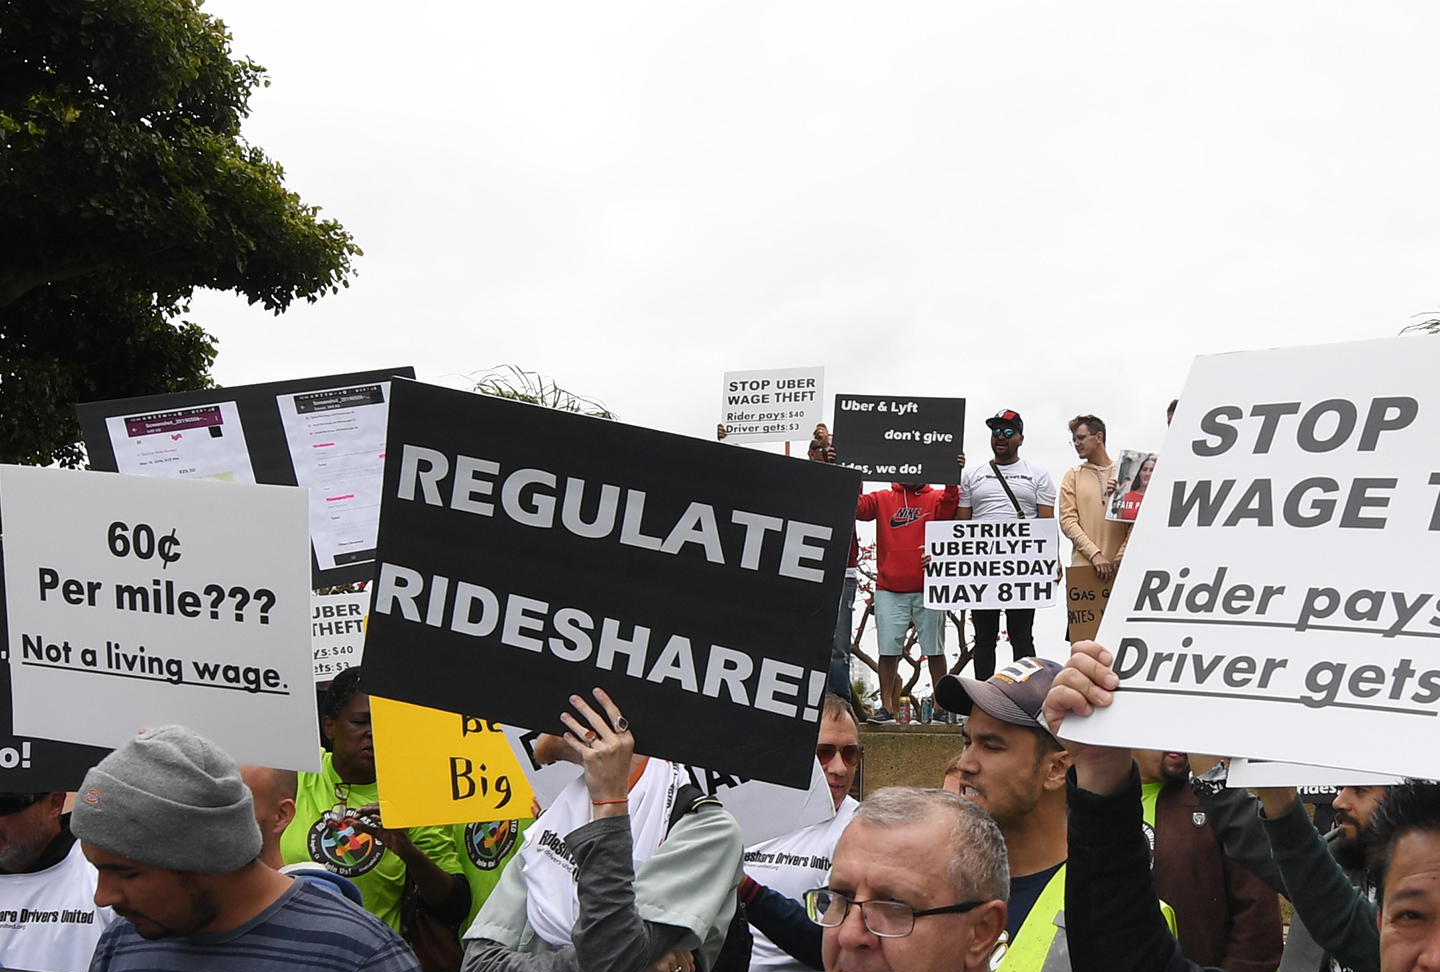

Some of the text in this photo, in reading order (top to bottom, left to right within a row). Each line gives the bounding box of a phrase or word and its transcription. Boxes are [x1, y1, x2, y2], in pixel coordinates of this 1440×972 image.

[729, 378, 816, 392] STOP UBER
[727, 391, 816, 405] WAGE THEFT
[727, 411, 756, 421] Rider
[841, 400, 919, 415] Uber & Lyft
[726, 424, 760, 434] Driver
[1191, 396, 1418, 456] STOP
[884, 429, 953, 445] don't give
[875, 464, 897, 475] we
[899, 463, 923, 475] do!
[1116, 500, 1134, 510] FAIR
[1167, 477, 1398, 529] WAGE
[396, 443, 834, 583] REGULATE
[895, 507, 922, 519] NIKE
[952, 522, 1031, 539] STRIKE
[107, 521, 182, 570] 60¢
[931, 539, 1047, 556] UBER/LYFT
[926, 559, 1057, 578] WEDNESDAY
[38, 567, 277, 625] Per mile???
[928, 581, 1052, 604] MAY 8TH
[1133, 566, 1286, 617] Rider
[375, 562, 828, 723] RIDESHARE!
[21, 633, 289, 693] Not a living wage.
[1113, 636, 1288, 689] Driver
[449, 757, 512, 810] Big
[775, 852, 809, 867] Drivers
[20, 908, 59, 923] Drivers
[60, 909, 95, 925] United
